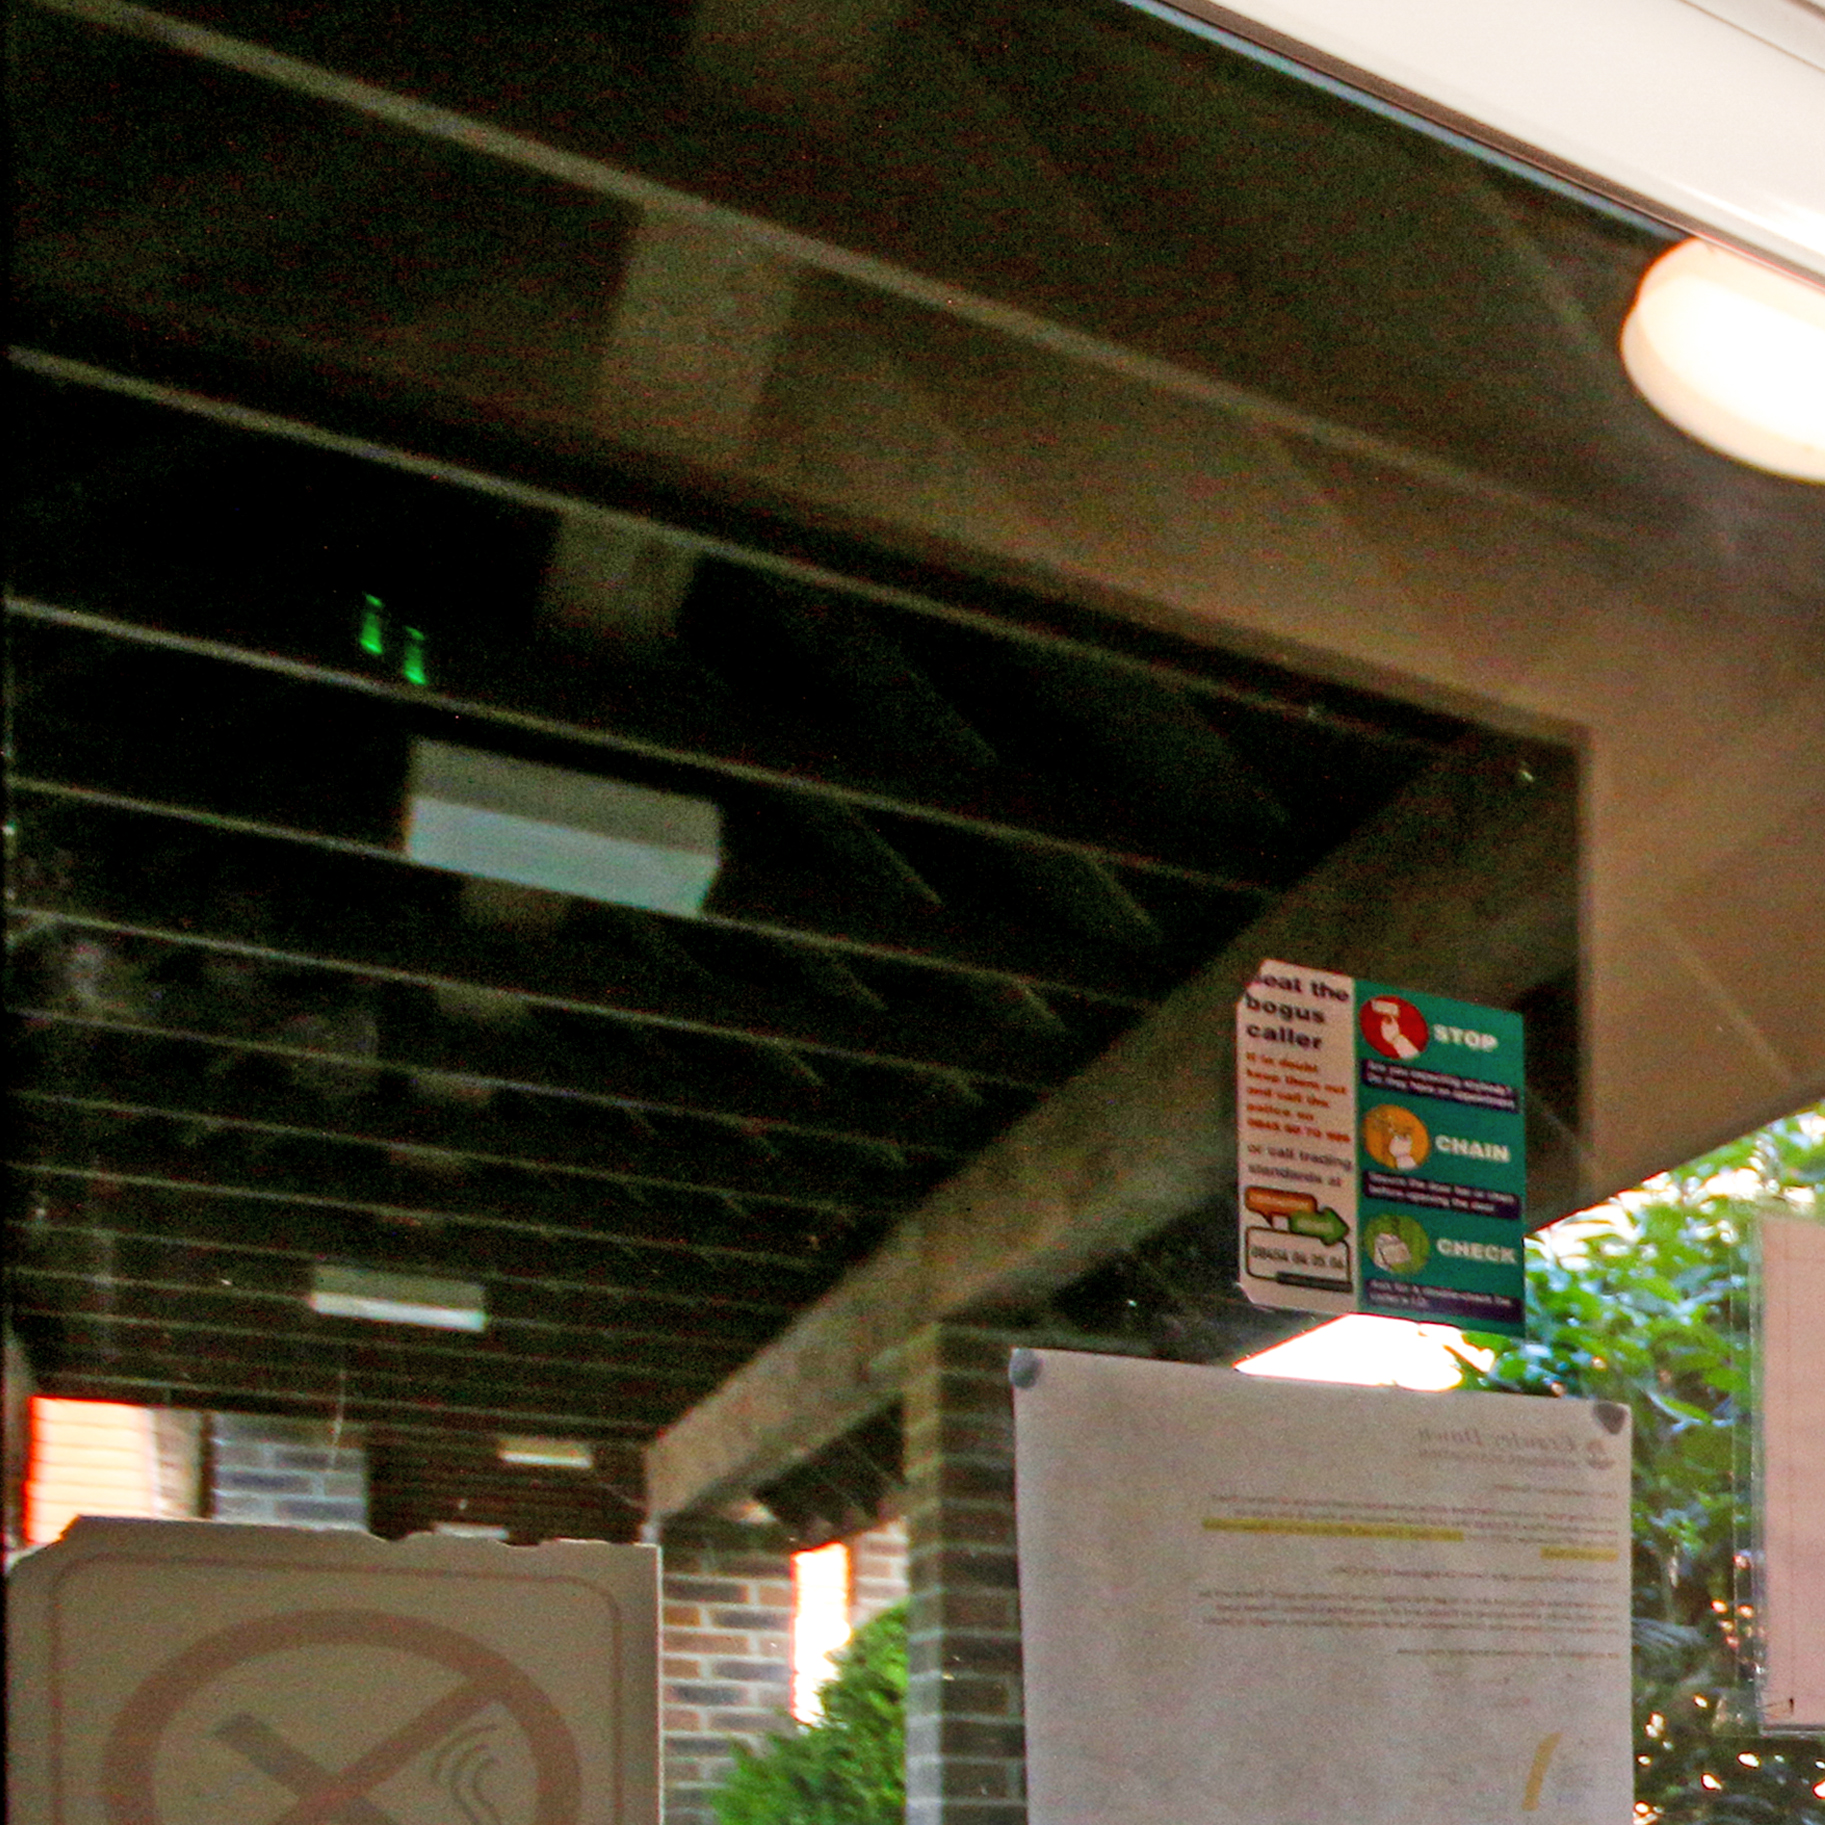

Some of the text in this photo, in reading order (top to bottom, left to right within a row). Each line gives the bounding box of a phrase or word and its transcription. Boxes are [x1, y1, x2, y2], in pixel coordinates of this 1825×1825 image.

[1256, 974, 1349, 1001] eat the
[1246, 993, 1325, 1022] bogus
[1246, 1024, 1322, 1050] caller
[1433, 1023, 1499, 1053] STOP
[1435, 1134, 1511, 1163] CHAIN
[1436, 1237, 1517, 1264] CHECK
